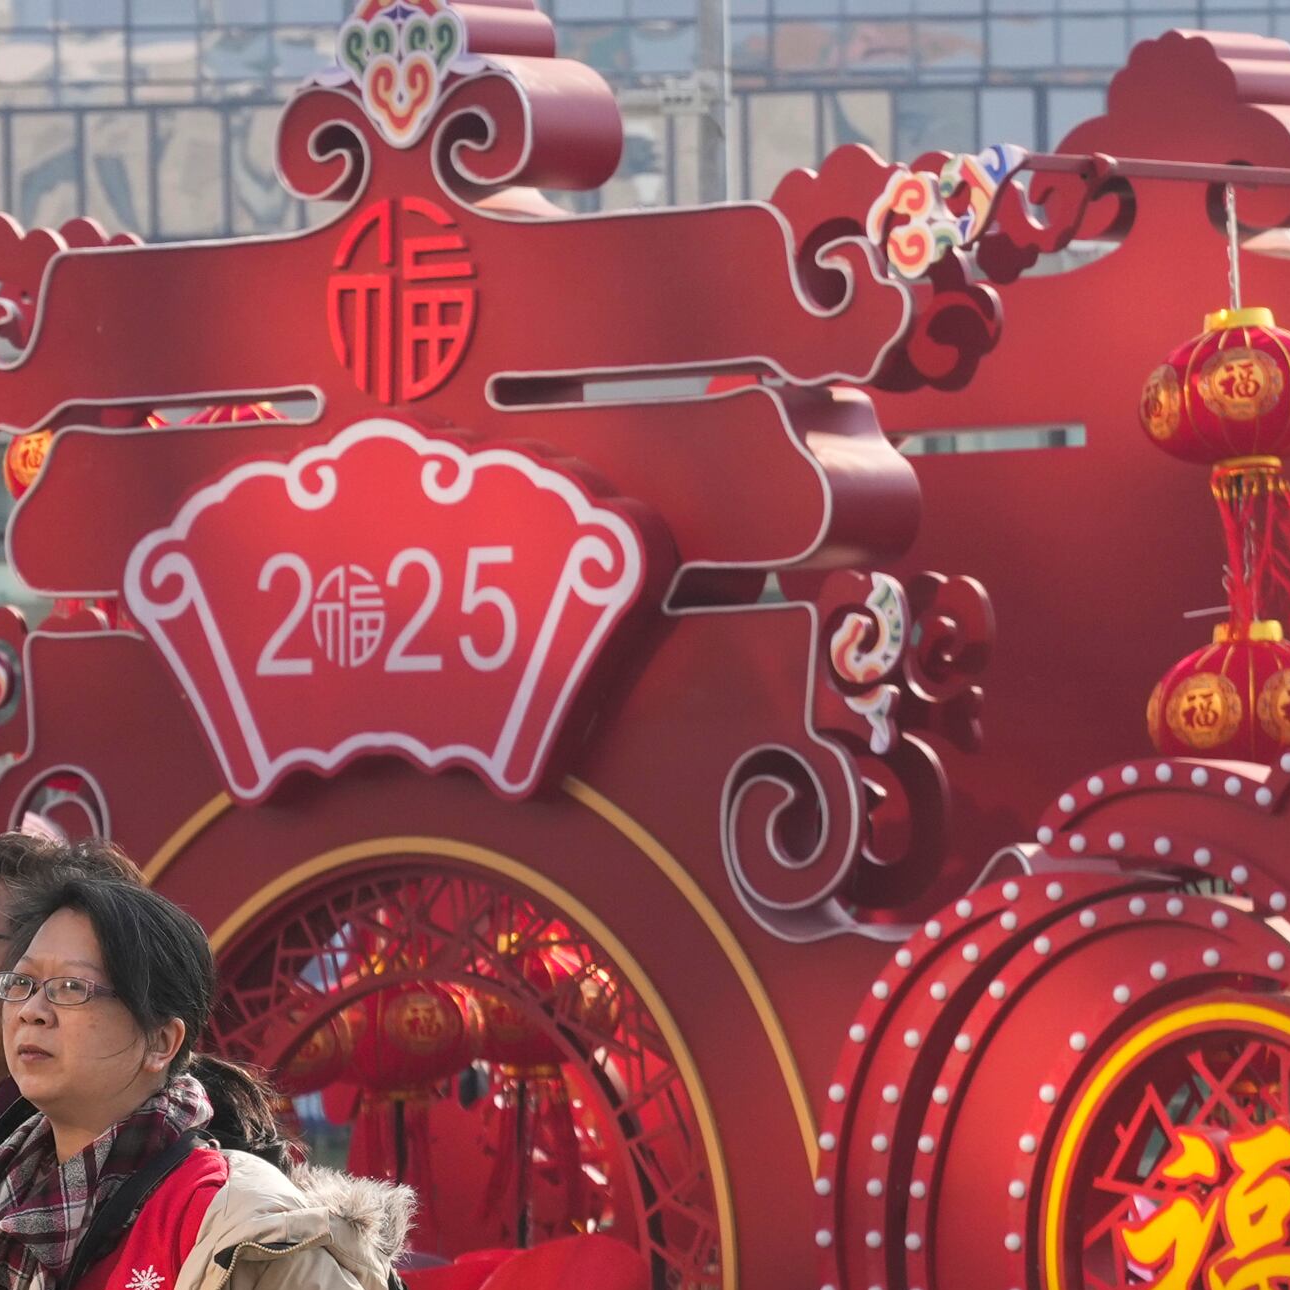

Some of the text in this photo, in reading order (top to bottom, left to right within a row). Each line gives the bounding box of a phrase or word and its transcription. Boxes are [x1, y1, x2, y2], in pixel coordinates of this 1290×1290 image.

[327, 196, 478, 405] 福
[1217, 362, 1261, 399] 福
[1182, 693, 1219, 729] 福
